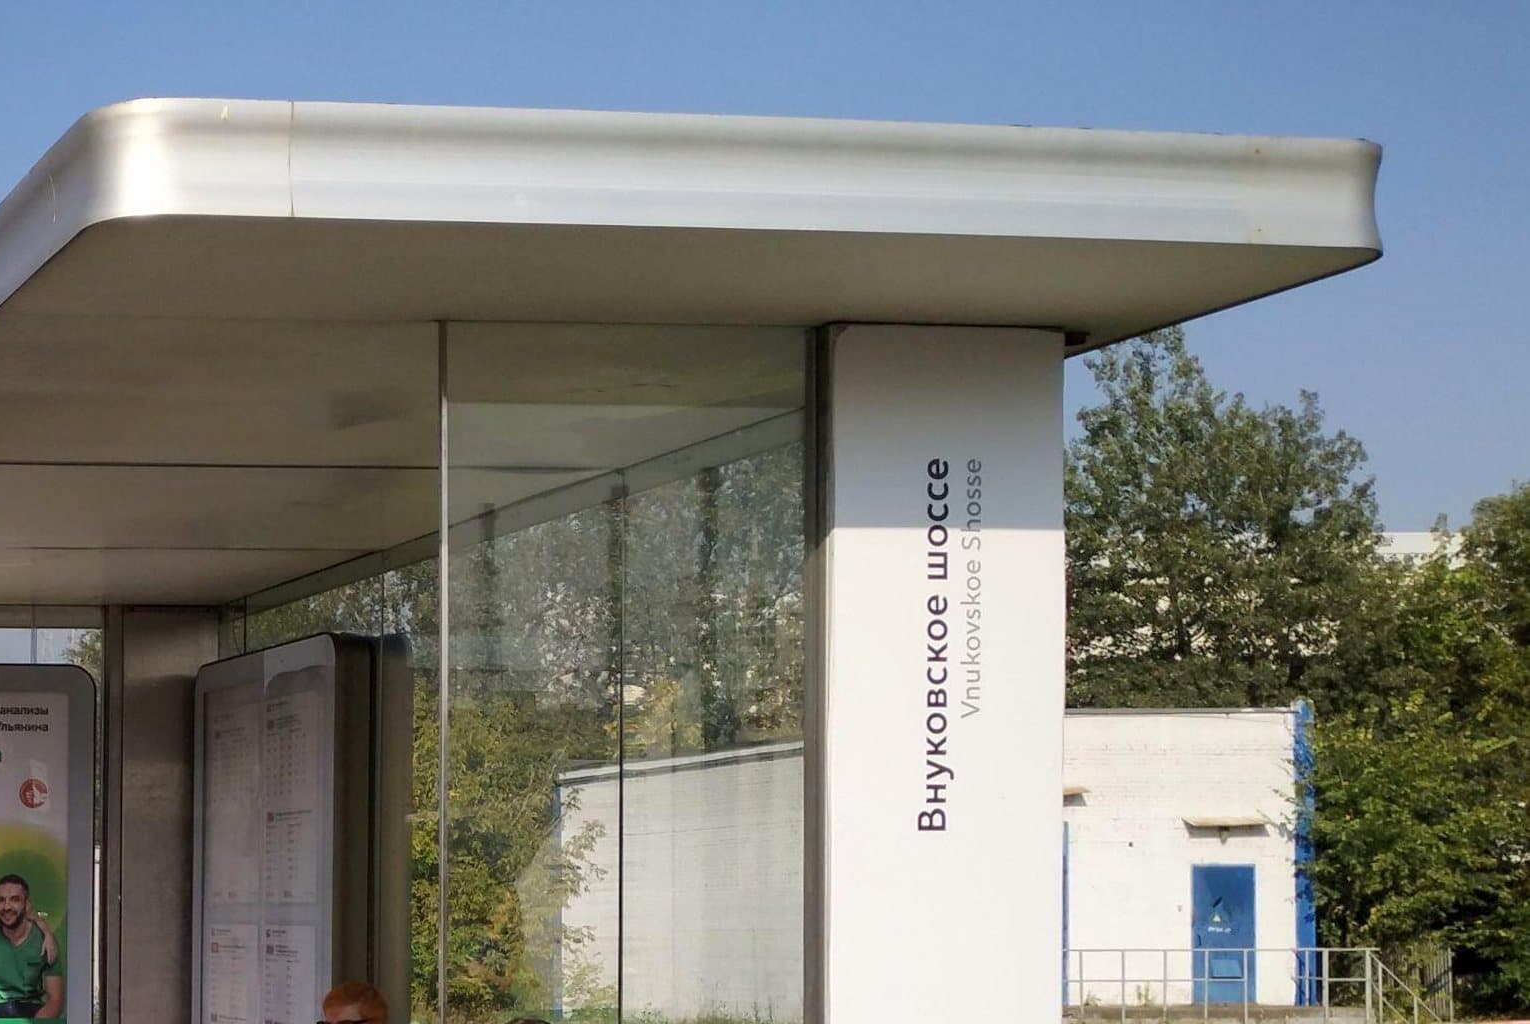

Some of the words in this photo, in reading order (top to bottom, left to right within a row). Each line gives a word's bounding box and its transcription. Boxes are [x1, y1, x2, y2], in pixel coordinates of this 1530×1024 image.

[927, 457, 950, 581] шоссе
[960, 457, 982, 551] Shosse
[960, 558, 982, 719] Vnukovskoe
[0, 706, 49, 716] анализы
[917, 594, 954, 832] Внуковское
